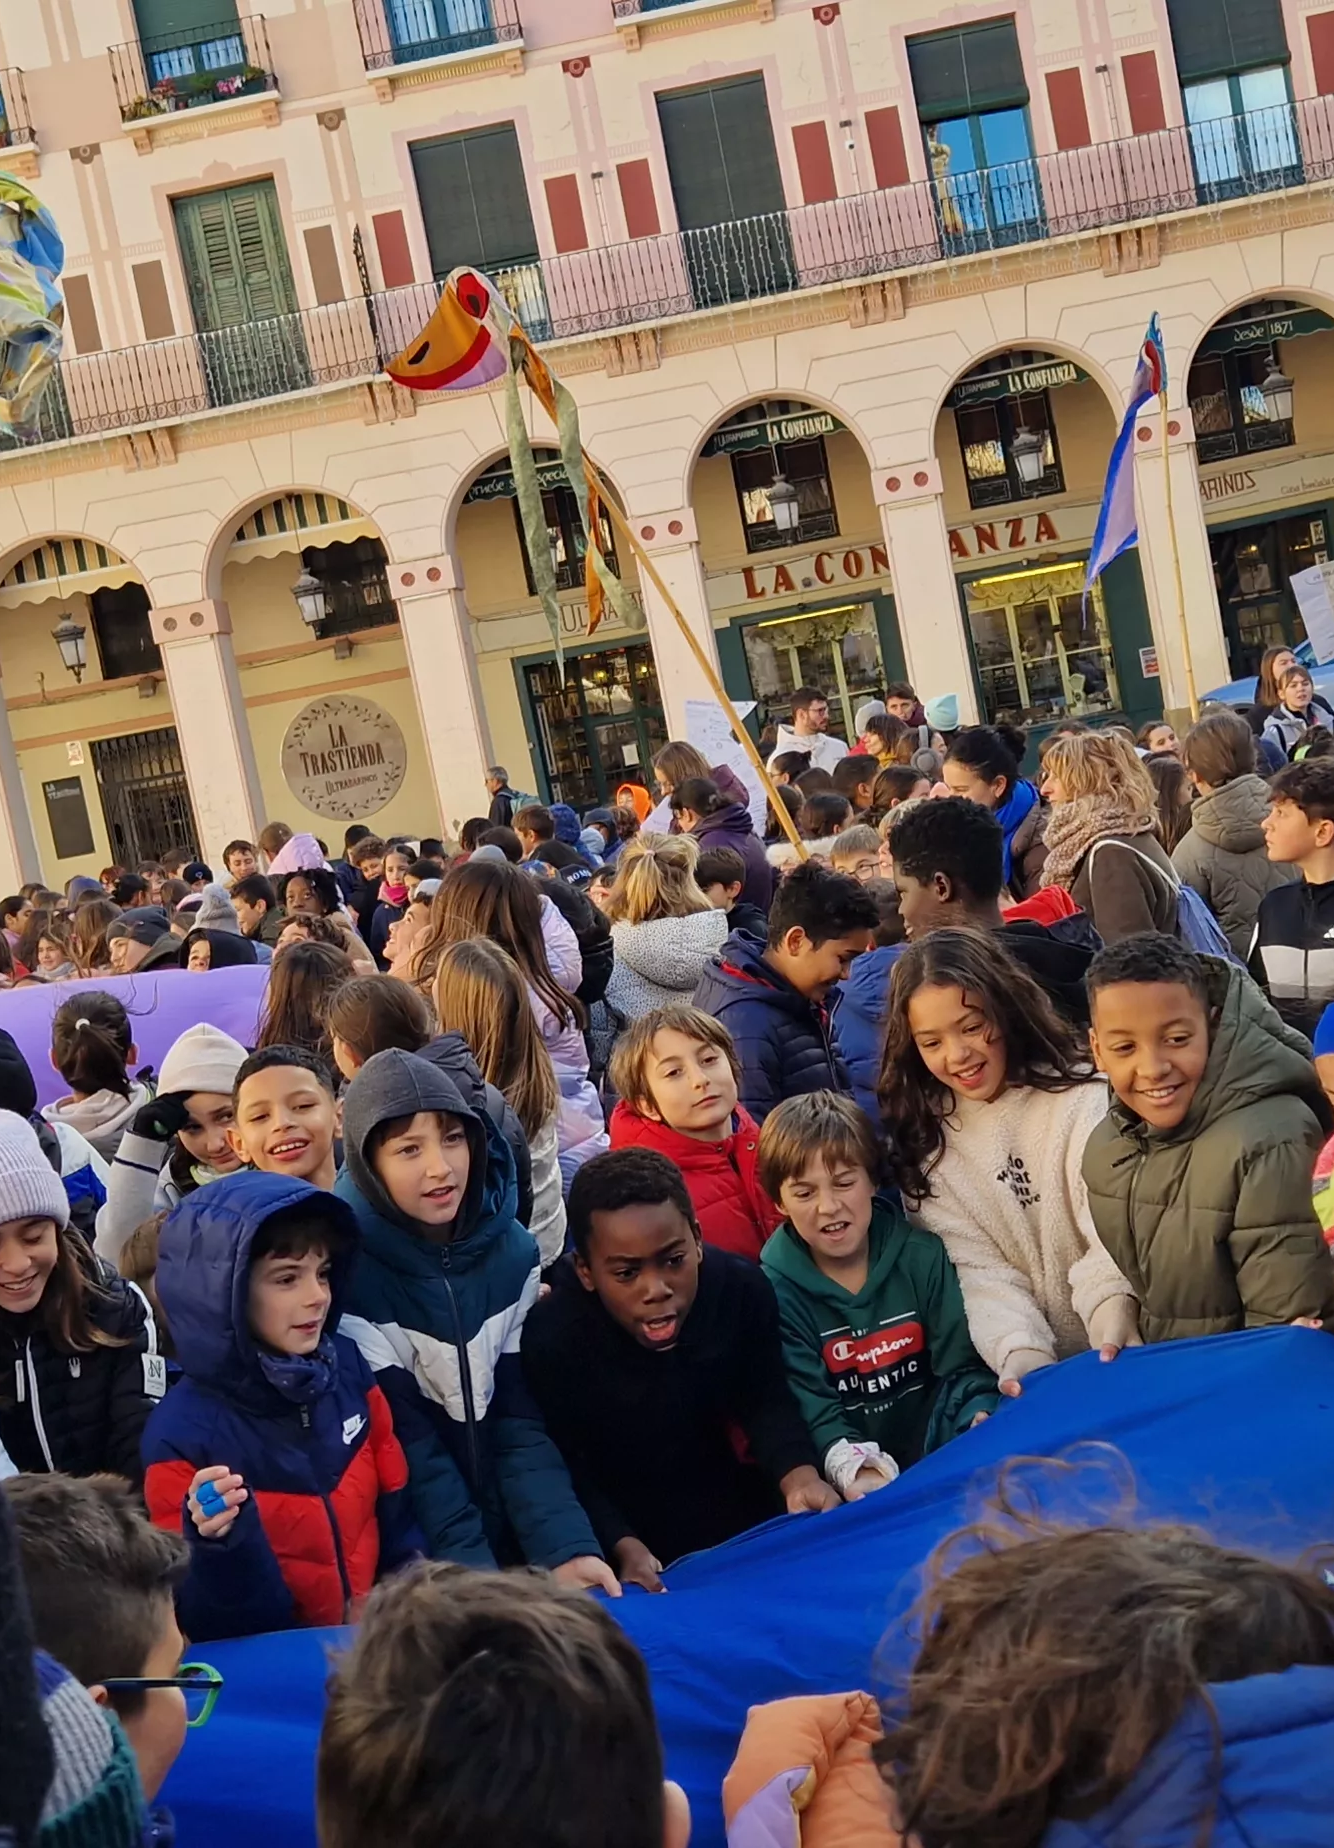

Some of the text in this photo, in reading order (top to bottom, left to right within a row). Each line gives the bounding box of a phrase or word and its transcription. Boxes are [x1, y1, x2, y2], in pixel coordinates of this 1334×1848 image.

[1234, 320, 1293, 342] desde 1871
[1008, 373, 1022, 393] LA
[1022, 363, 1077, 389] CONFIANZA
[766, 422, 780, 442] LA
[780, 415, 834, 440] CONFIANZA
[742, 563, 797, 600] LA
[328, 724, 348, 748] LA
[299, 742, 385, 777] TRASTIENDA
[1020, 1194, 1041, 1210] ove
[833, 1337, 914, 1365] Cmpion
